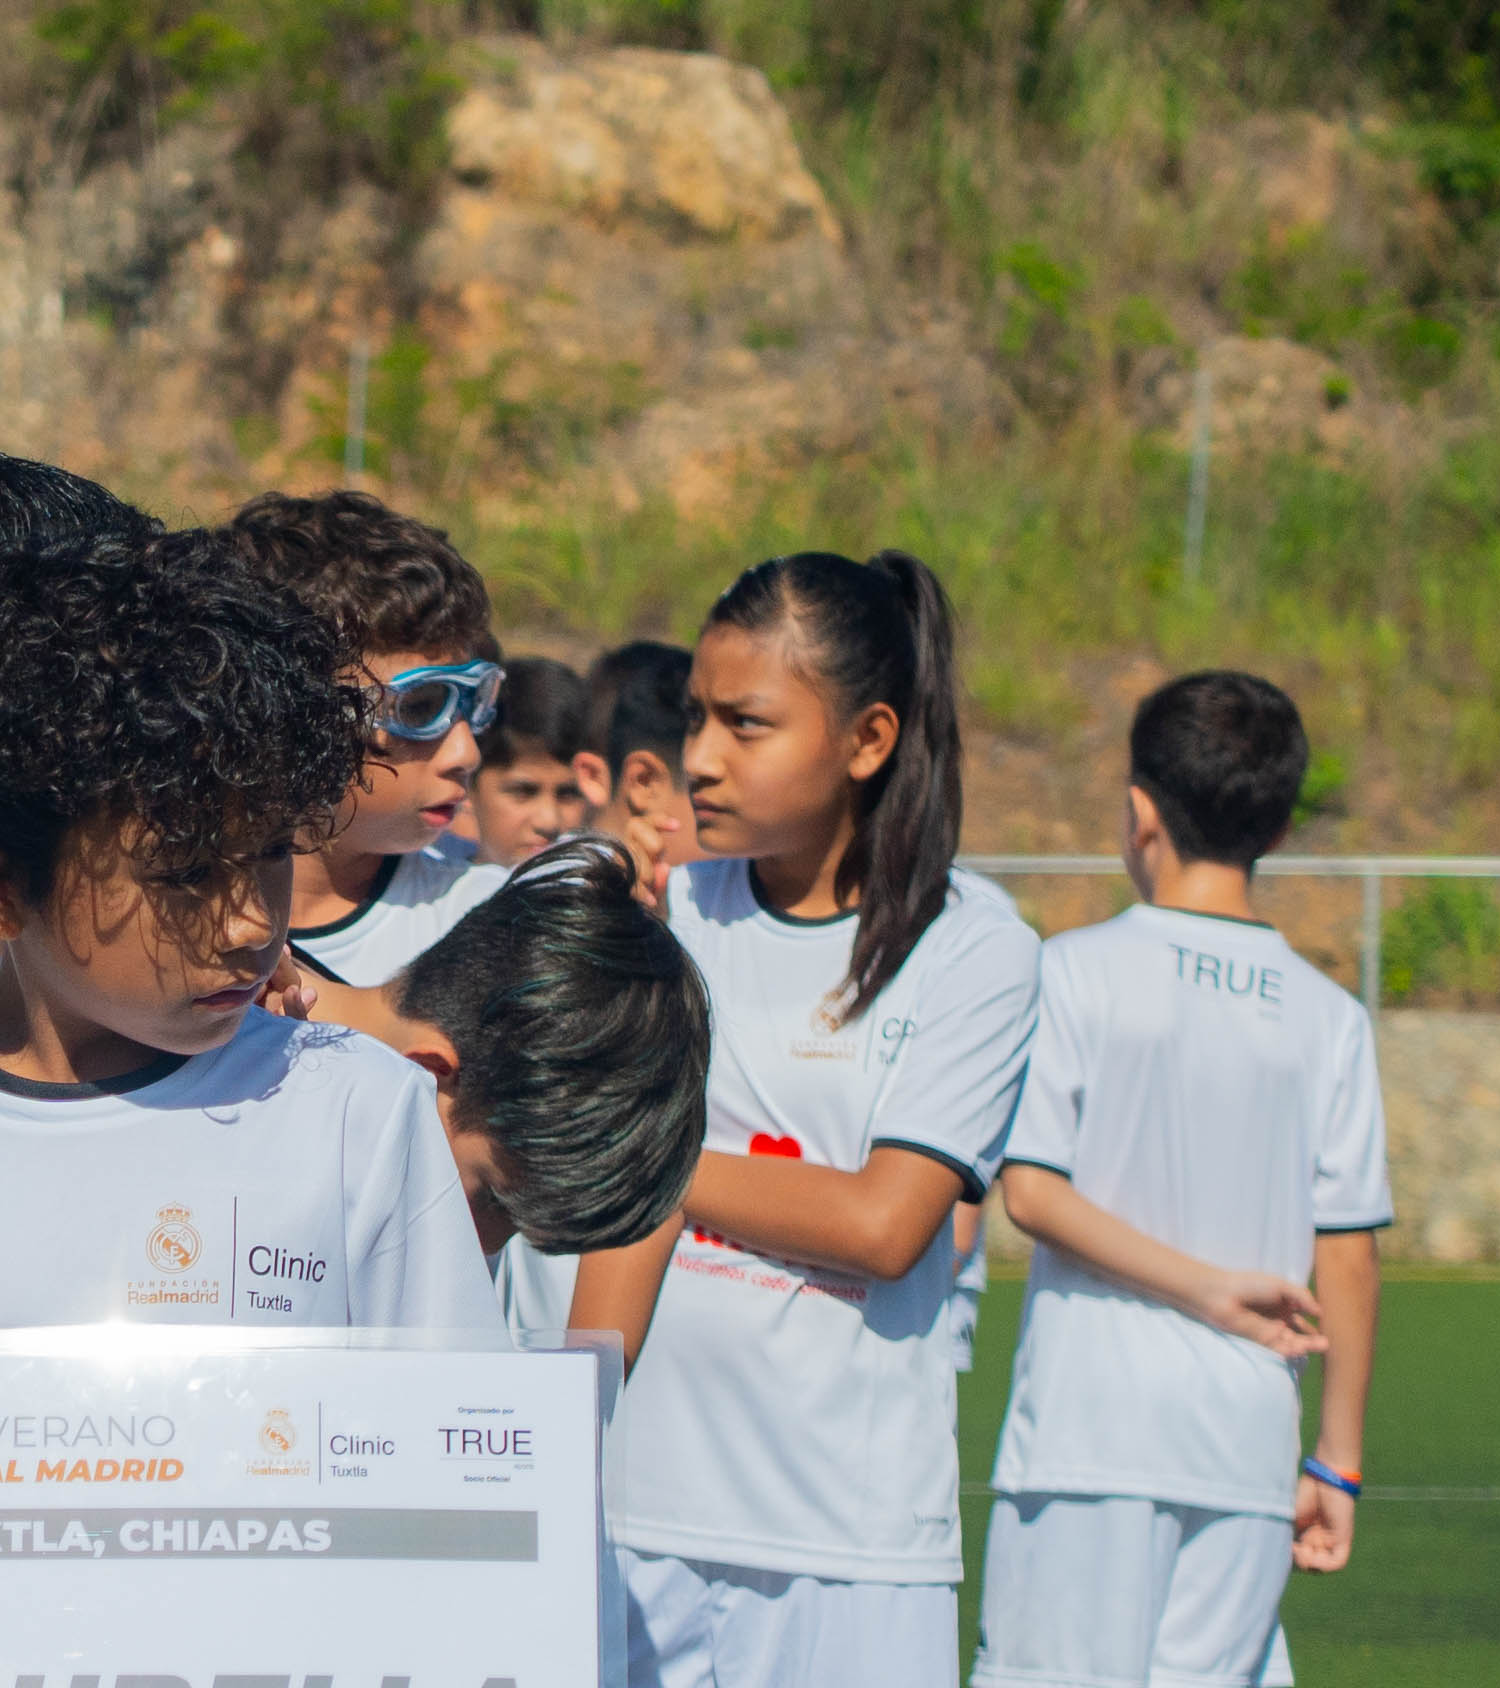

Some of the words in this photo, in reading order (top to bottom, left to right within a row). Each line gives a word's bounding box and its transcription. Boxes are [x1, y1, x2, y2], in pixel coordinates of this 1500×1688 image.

[1167, 942, 1284, 1003] TRUE
[248, 1245, 326, 1283] Clinic
[246, 1290, 293, 1313] Tuxtla
[329, 1434, 395, 1456] Clinic
[437, 1427, 533, 1456] TRUE
[34, 1457, 185, 1484] MADRID
[330, 1464, 369, 1479] Tuxtla
[119, 1518, 333, 1553] CHIAPAS
